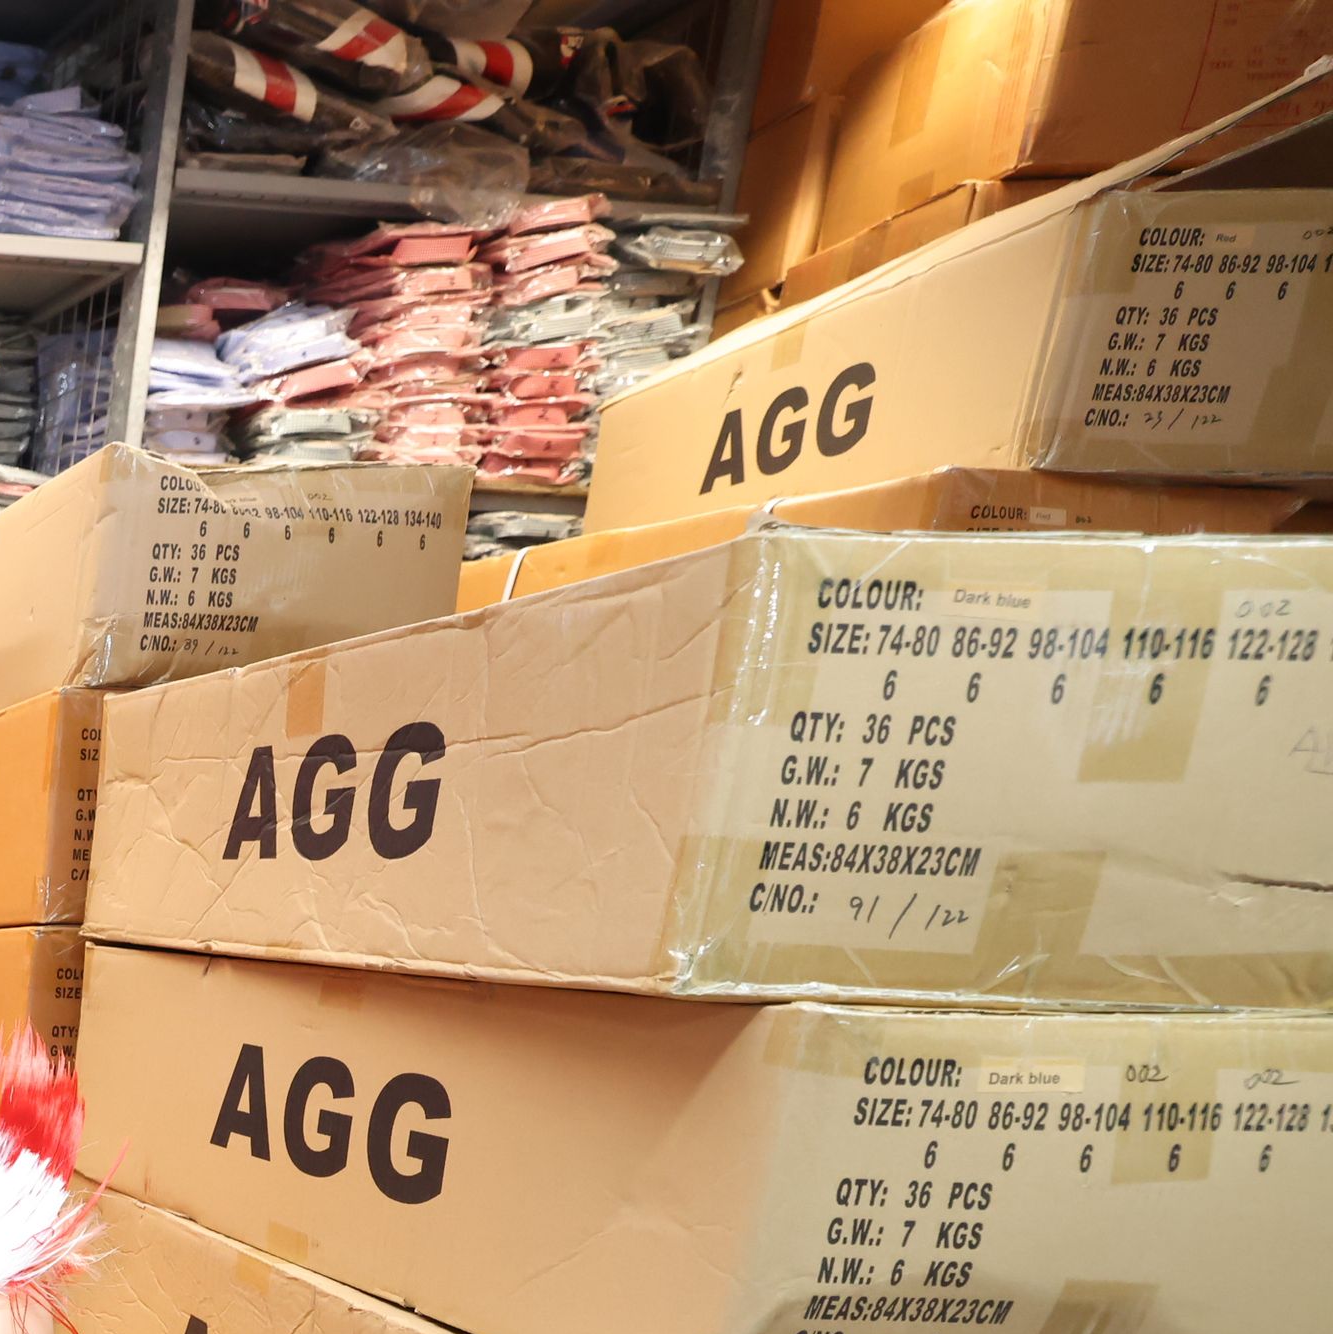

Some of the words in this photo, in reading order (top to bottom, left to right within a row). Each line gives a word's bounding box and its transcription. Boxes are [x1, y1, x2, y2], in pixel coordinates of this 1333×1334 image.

[1139, 228, 1205, 246] COLOUR:
[1219, 255, 1261, 273] 86-92
[1266, 254, 1317, 273] 98-104
[1116, 306, 1149, 325] QTY:
[1159, 307, 1179, 325] 36
[1187, 308, 1218, 326] PCS
[1108, 333, 1145, 350] G.W.:
[1156, 333, 1166, 351] 7
[1178, 334, 1210, 351] KGS
[1100, 358, 1136, 376] N.W.:
[1147, 359, 1156, 376] 6
[1170, 359, 1201, 377] KGS
[699, 362, 875, 495] AGG
[153, 543, 181, 560] QTY:
[191, 544, 206, 560] 36
[216, 544, 239, 561] PCS
[150, 566, 181, 583] G.W.:
[192, 567, 198, 583] 7
[212, 568, 236, 584] KGS
[818, 578, 923, 610] COLOUR:
[954, 588, 990, 604] Dark
[996, 593, 1031, 608] blue
[952, 626, 1017, 658] 86-92
[1028, 628, 1110, 659] 98-104
[1124, 628, 1215, 659] 110-116
[1229, 629, 1319, 661] 122-128
[883, 670, 897, 700] 6
[967, 673, 981, 703] 6
[1051, 674, 1066, 704] 6
[1149, 673, 1164, 704] 6
[1255, 675, 1271, 706] 6
[791, 711, 844, 742] QTY:
[863, 714, 891, 744] 36
[908, 716, 956, 746] PCS
[781, 755, 839, 786] G.W.:
[859, 758, 873, 787] 7
[895, 759, 945, 790] KGS
[223, 722, 446, 860] AGG
[770, 799, 829, 829] N.W.:
[846, 801, 861, 830] 6
[883, 803, 933, 833] KGS
[750, 883, 818, 913] C/NO.:
[864, 1057, 962, 1087] COLOUR:
[989, 1072, 1023, 1085] Dark
[1029, 1072, 1060, 1084] blue
[210, 1044, 451, 1204] AGG
[988, 1101, 1048, 1130] 86-92
[1058, 1103, 1131, 1131] 98-104
[1144, 1103, 1222, 1131] 110-116
[1235, 1103, 1310, 1132] 122-128
